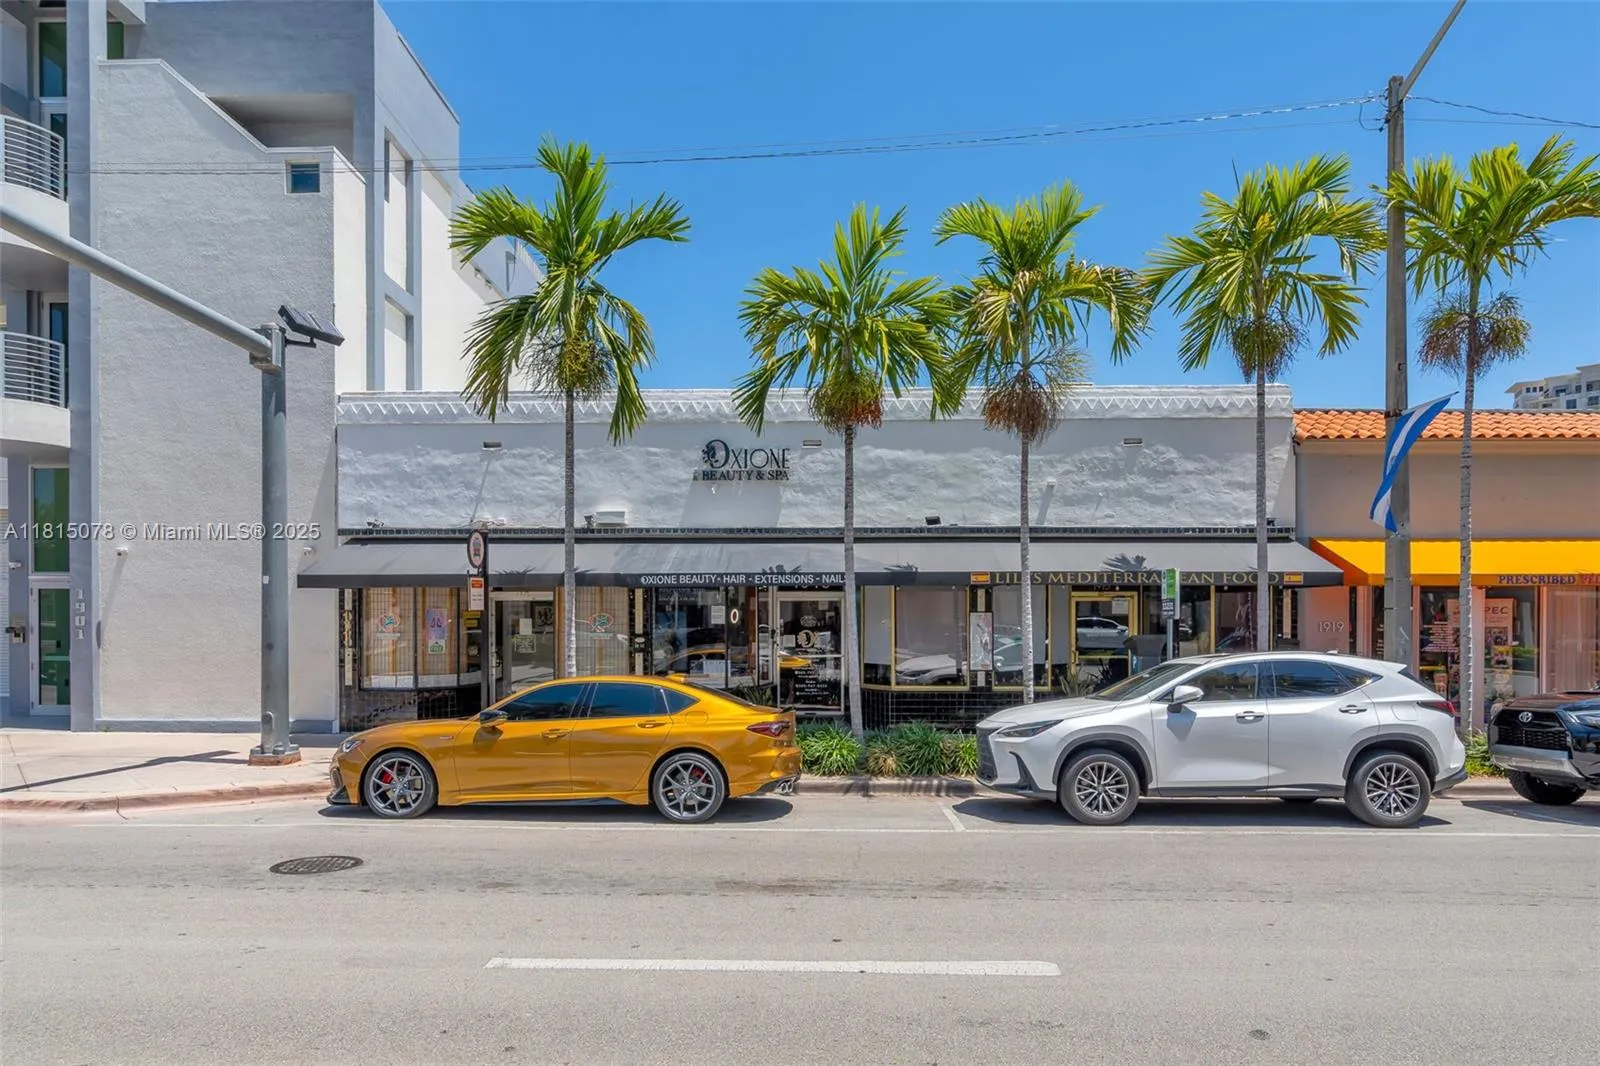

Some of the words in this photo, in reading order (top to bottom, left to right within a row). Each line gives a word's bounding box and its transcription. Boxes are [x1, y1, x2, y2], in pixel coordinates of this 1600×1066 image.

[702, 439, 790, 469] OXIONE
[702, 470, 753, 481] BEAUTY
[755, 470, 765, 480] &
[767, 470, 790, 481] SPA
[641, 574, 677, 585] OXIONE
[679, 574, 716, 585] BEAUTY
[723, 574, 746, 584] HAIR
[755, 574, 815, 585] EXTENSIONS
[1048, 571, 1215, 584] MEDITERRAEAN
[1499, 574, 1576, 585] PRESCRIBED
[1318, 620, 1345, 633] 1919
